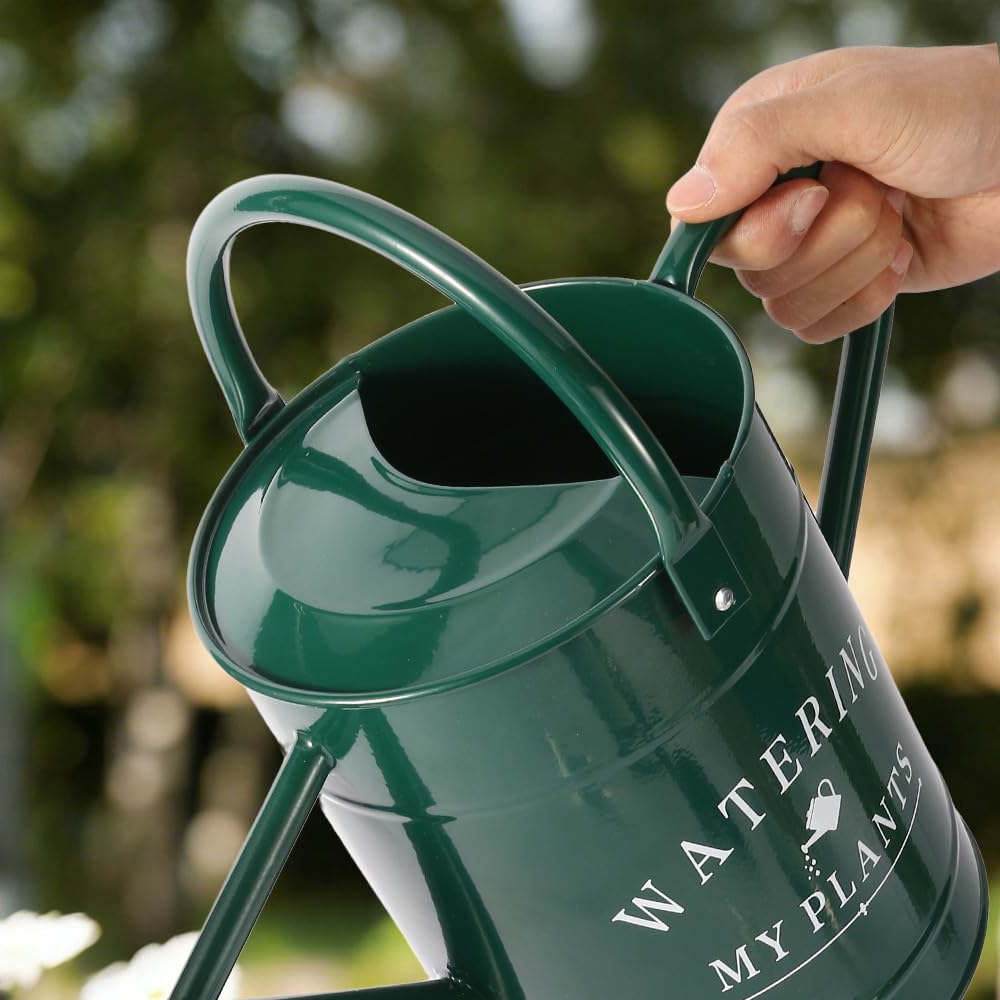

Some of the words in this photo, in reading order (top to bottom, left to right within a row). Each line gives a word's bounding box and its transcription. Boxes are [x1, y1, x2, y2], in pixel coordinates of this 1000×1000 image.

[612, 625, 878, 932] WATERING
[708, 920, 790, 993] MY
[800, 742, 913, 933] PLANTS
